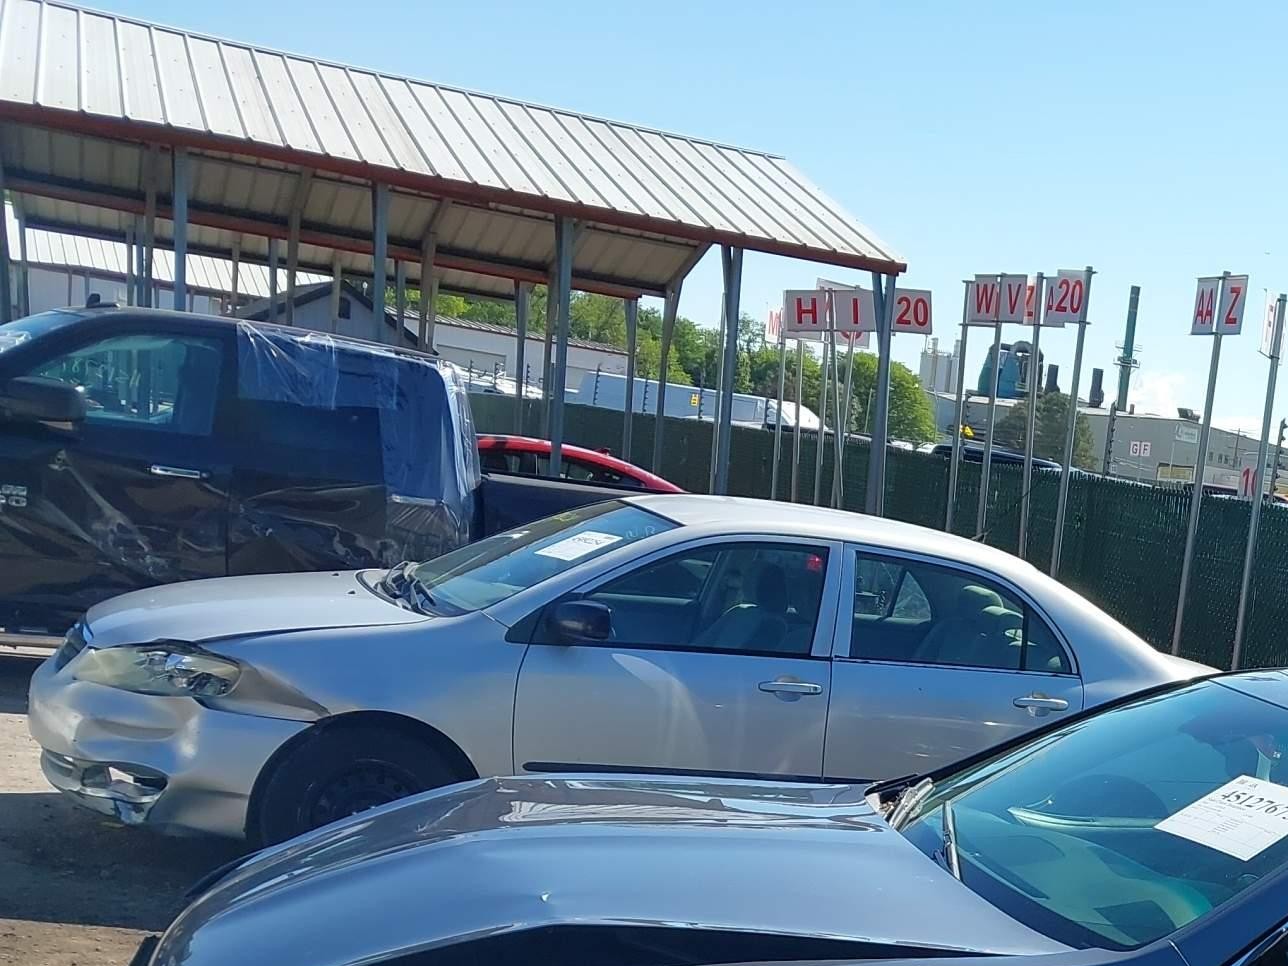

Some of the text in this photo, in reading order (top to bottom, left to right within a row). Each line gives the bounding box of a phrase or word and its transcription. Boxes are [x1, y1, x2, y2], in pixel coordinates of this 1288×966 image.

[796, 297, 818, 325] H
[851, 297, 859, 325] I
[895, 296, 929, 327] 20
[975, 283, 996, 314] W
[1007, 283, 1022, 315] V
[1055, 278, 1084, 314] 20
[1194, 287, 1214, 325] AA
[1224, 286, 1242, 325] Z
[1142, 444, 1149, 455] F
